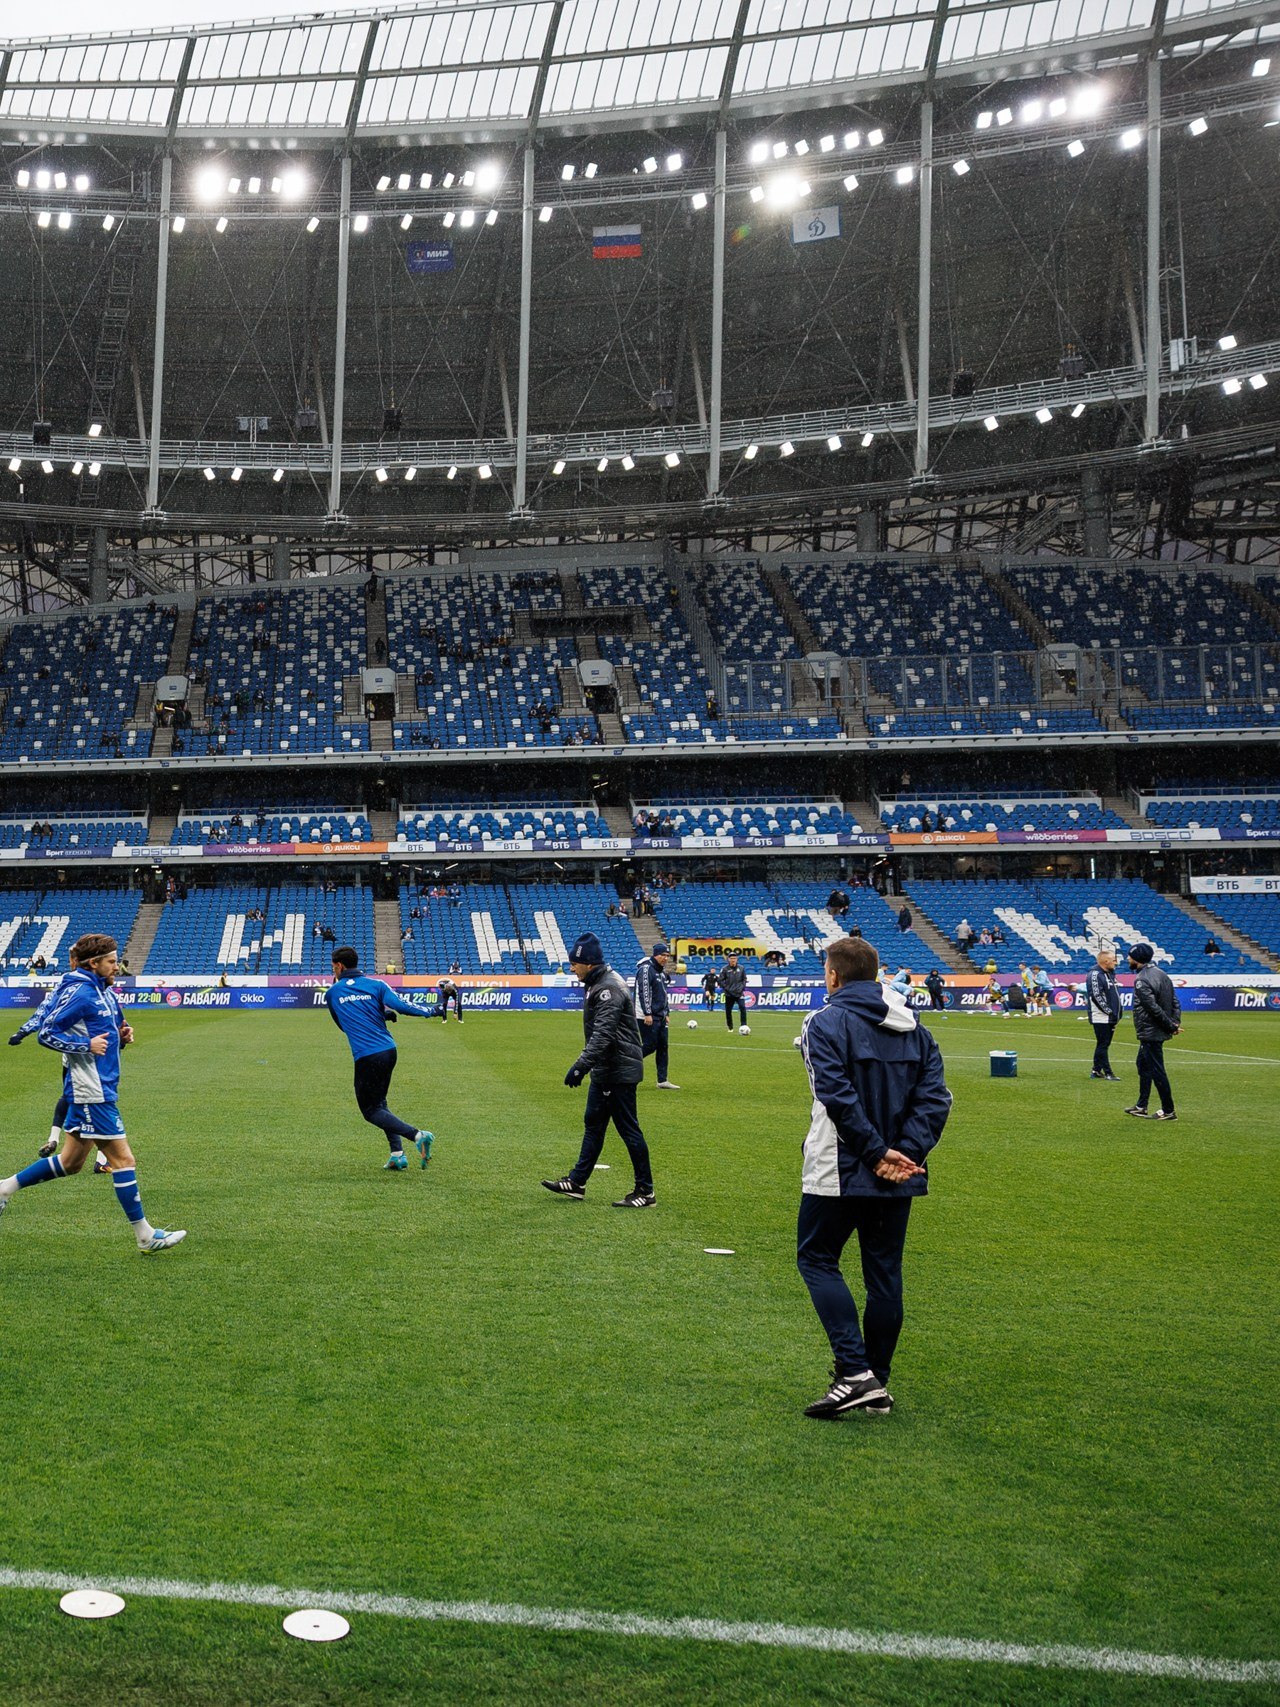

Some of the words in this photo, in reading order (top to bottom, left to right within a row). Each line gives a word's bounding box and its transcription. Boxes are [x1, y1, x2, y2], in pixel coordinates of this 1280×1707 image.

[427, 250, 449, 258] МИР
[1025, 832, 1079, 841] wildberries
[1246, 829, 1270, 838] Брит
[601, 840, 619, 848] ВТБ
[652, 840, 670, 848] ВТБ
[704, 839, 721, 847] ВТБ
[755, 838, 773, 846] ВТБ
[807, 836, 825, 845] ВТБ
[859, 836, 878, 844] ВТБ
[227, 845, 271, 854] wildberries
[407, 844, 424, 852] ВТБ
[455, 843, 472, 851] ВТБ
[504, 842, 521, 850] ВТБ
[552, 841, 570, 849] ВТБ
[1216, 881, 1239, 890] ВТБ
[1265, 881, 1280, 890] ВТ
[688, 944, 756, 957] BetBoom
[137, 993, 162, 1003] 22:00
[183, 992, 231, 1005] БАВАРИЯ
[339, 993, 373, 1005] BetBoom
[412, 992, 438, 1004] 22:00
[460, 993, 511, 1006] БАВАРИЯ
[757, 992, 812, 1006] БАВАРИЯ
[961, 993, 975, 1005] 28
[1234, 993, 1268, 1007] ПСЖ
